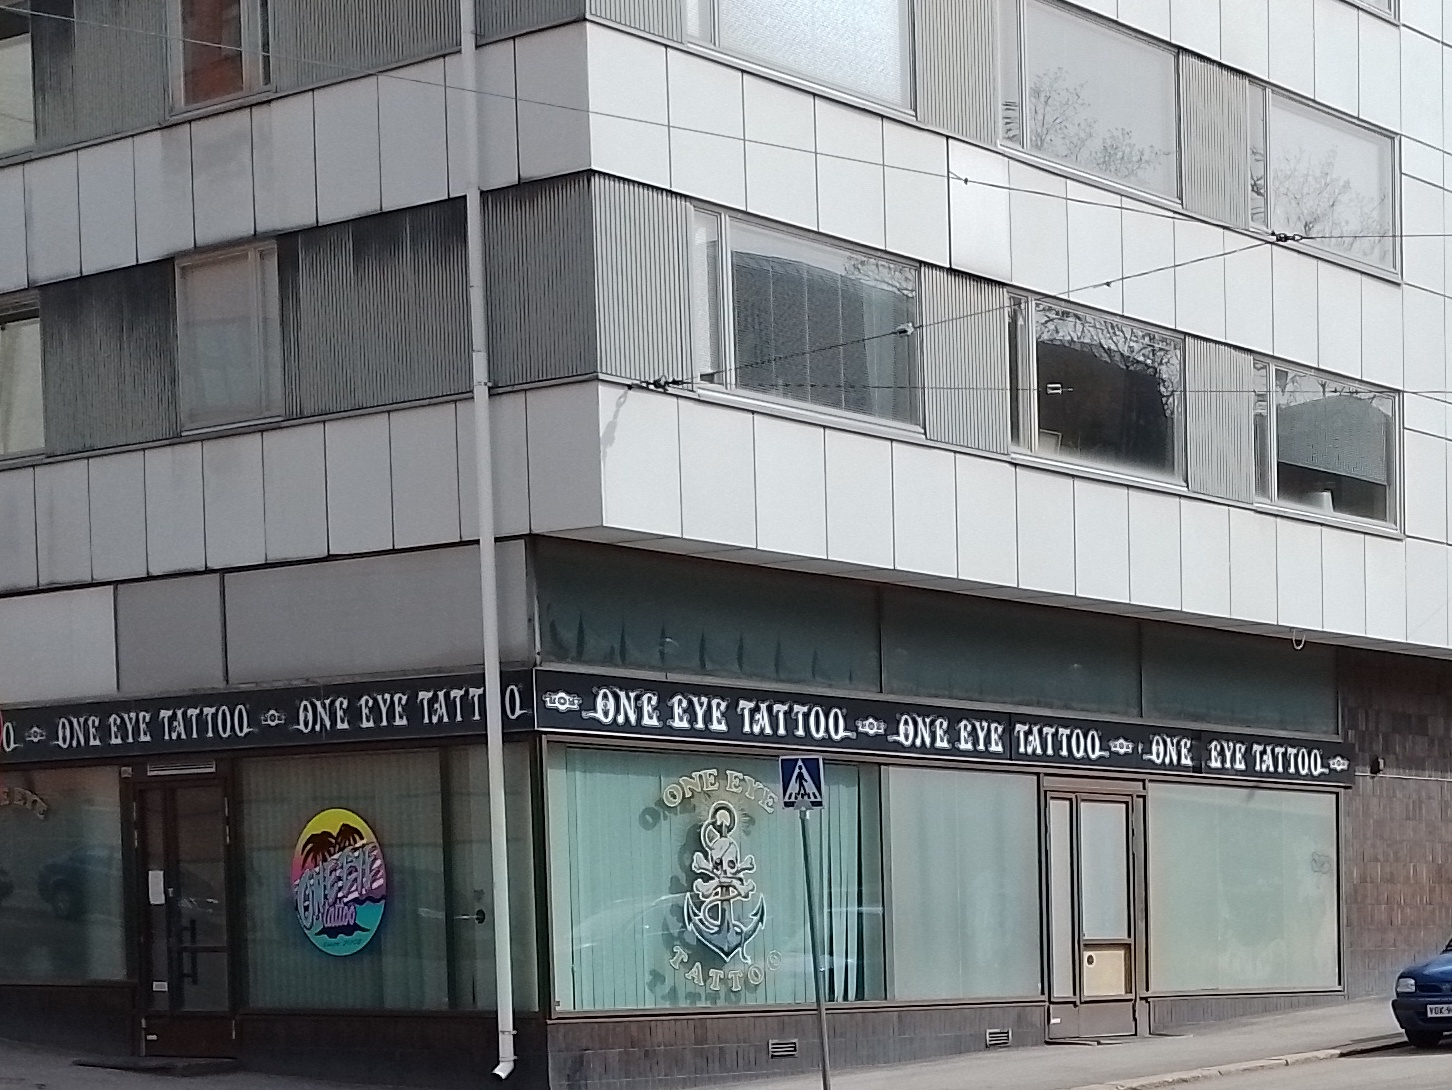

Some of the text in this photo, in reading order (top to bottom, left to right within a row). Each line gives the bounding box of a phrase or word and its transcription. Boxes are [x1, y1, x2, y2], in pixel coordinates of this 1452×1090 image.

[51, 716, 101, 748] ONE
[108, 711, 151, 745] EYE
[158, 704, 255, 741] TATTOO
[291, 684, 529, 734] ONE EYE TATTO
[582, 686, 856, 741] ONE EYE TATTOO
[888, 714, 1109, 759] ONE EYE TATTOO
[1143, 733, 1329, 776] ONE EYE TATTOO
[663, 769, 778, 814] ONE EYE
[670, 946, 782, 991] TATTOO
